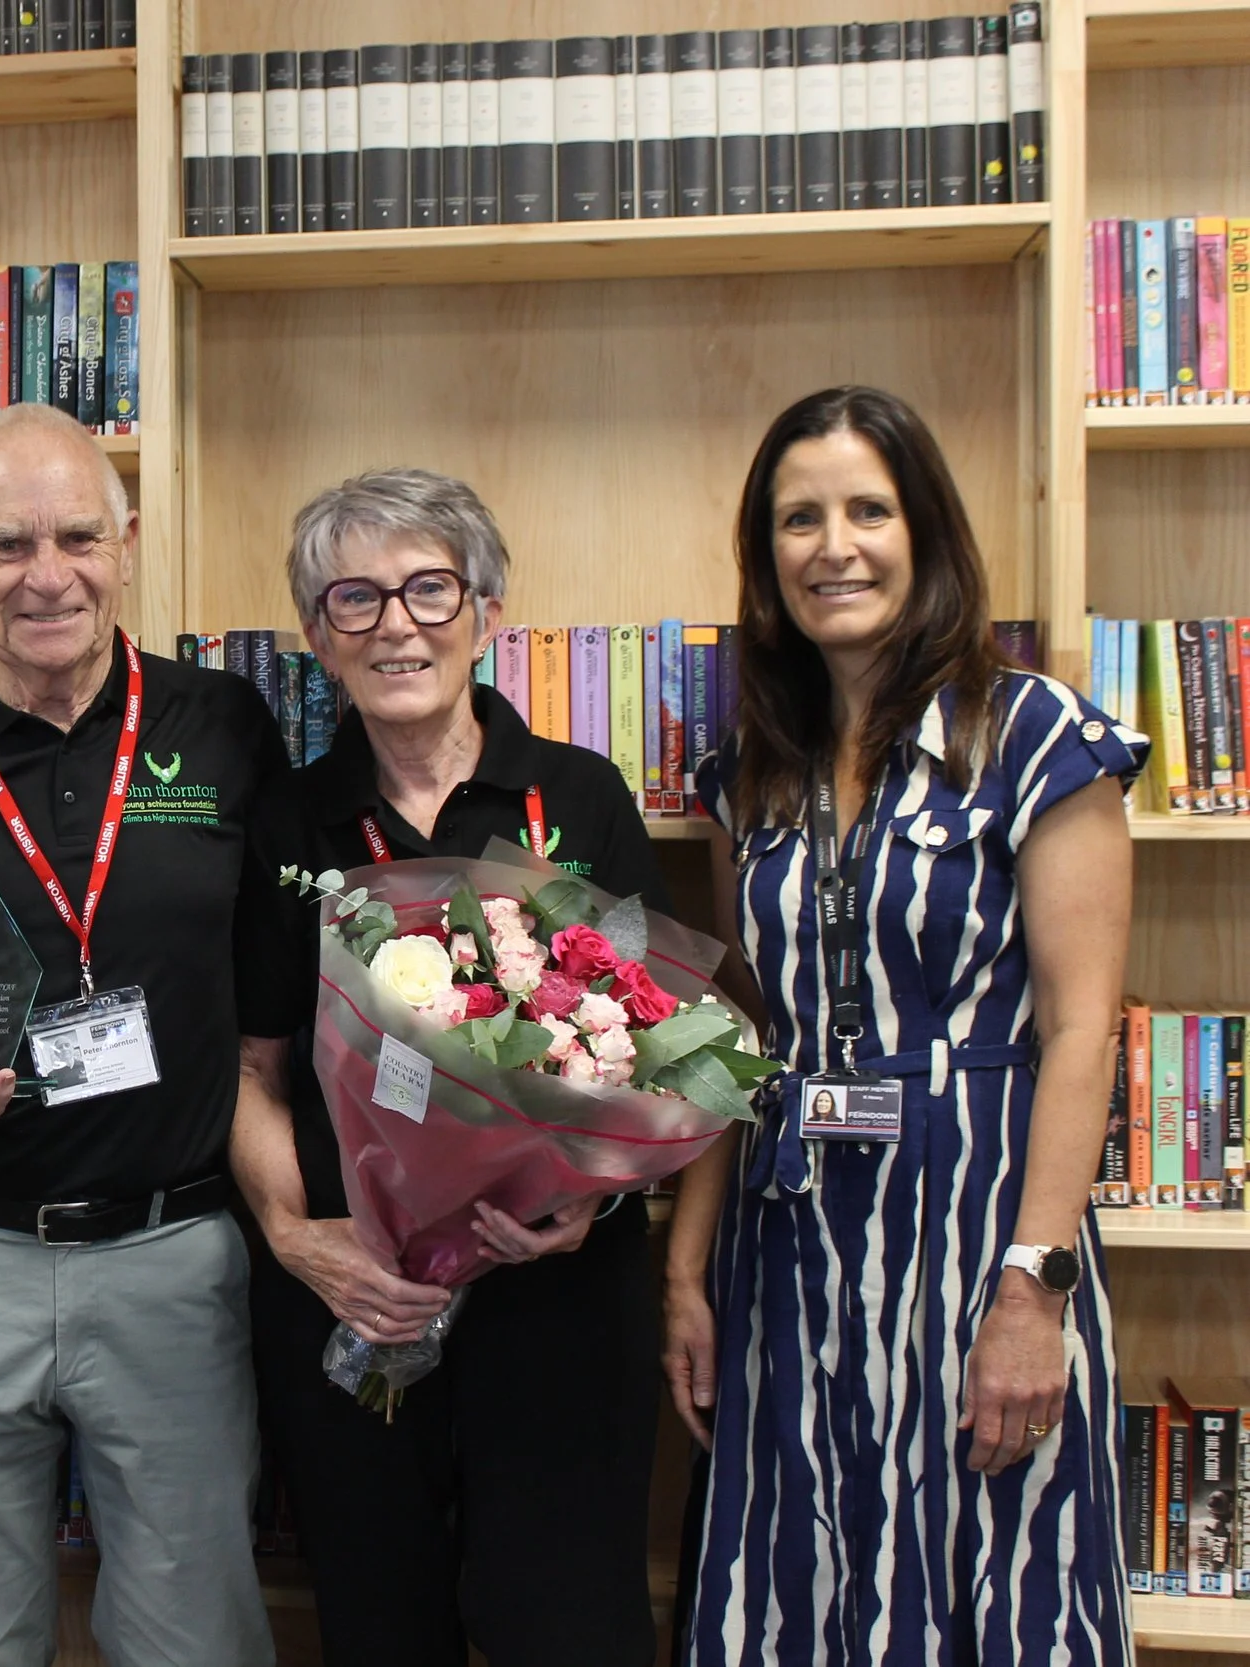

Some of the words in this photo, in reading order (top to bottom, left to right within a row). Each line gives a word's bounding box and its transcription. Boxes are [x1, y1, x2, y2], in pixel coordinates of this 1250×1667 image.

[1232, 228, 1248, 292] FLOORED
[57, 316, 71, 341] City
[85, 316, 98, 341] City
[117, 316, 131, 340] City
[59, 347, 71, 357] of
[119, 346, 130, 356] of
[59, 360, 72, 399] Ashes
[86, 361, 98, 400] Bones
[118, 360, 130, 385] Lost
[126, 643, 139, 673] VISITOR
[125, 694, 138, 732] VISITOR
[694, 682, 706, 718] ROWELL
[694, 724, 706, 756] CARRY
[112, 755, 129, 796] VISITOR
[156, 784, 217, 798] thornton
[820, 784, 830, 812] STAFF
[122, 801, 145, 810] young
[147, 799, 181, 808] achievers
[122, 815, 142, 823] climb
[152, 814, 167, 823] high
[10, 815, 36, 858] VISITOR
[96, 821, 115, 863] VISITOR
[362, 816, 384, 858] VISITOR
[46, 878, 71, 922] VISITOR
[824, 893, 837, 925] STAFF
[846, 886, 856, 920] STAFF
[90, 1020, 126, 1032] FERNDOWN
[1210, 1023, 1219, 1039] The
[83, 1046, 103, 1055] Peter
[384, 1063, 424, 1089] CHARM
[386, 1055, 424, 1080] COUNTRY
[1134, 1049, 1145, 1083] NOTHING
[1209, 1042, 1219, 1112] Cardturner
[398, 1091, 404, 1099] 5
[1140, 1432, 1151, 1450] long
[1173, 1433, 1184, 1462] ARTHUR
[1204, 1435, 1220, 1481] HALDEMAN
[1141, 1488, 1150, 1510] small
[1173, 1473, 1184, 1499] CLARKE
[1139, 1539, 1149, 1565] planet
[1197, 1536, 1209, 1552] and
[1211, 1536, 1227, 1562] Peace
